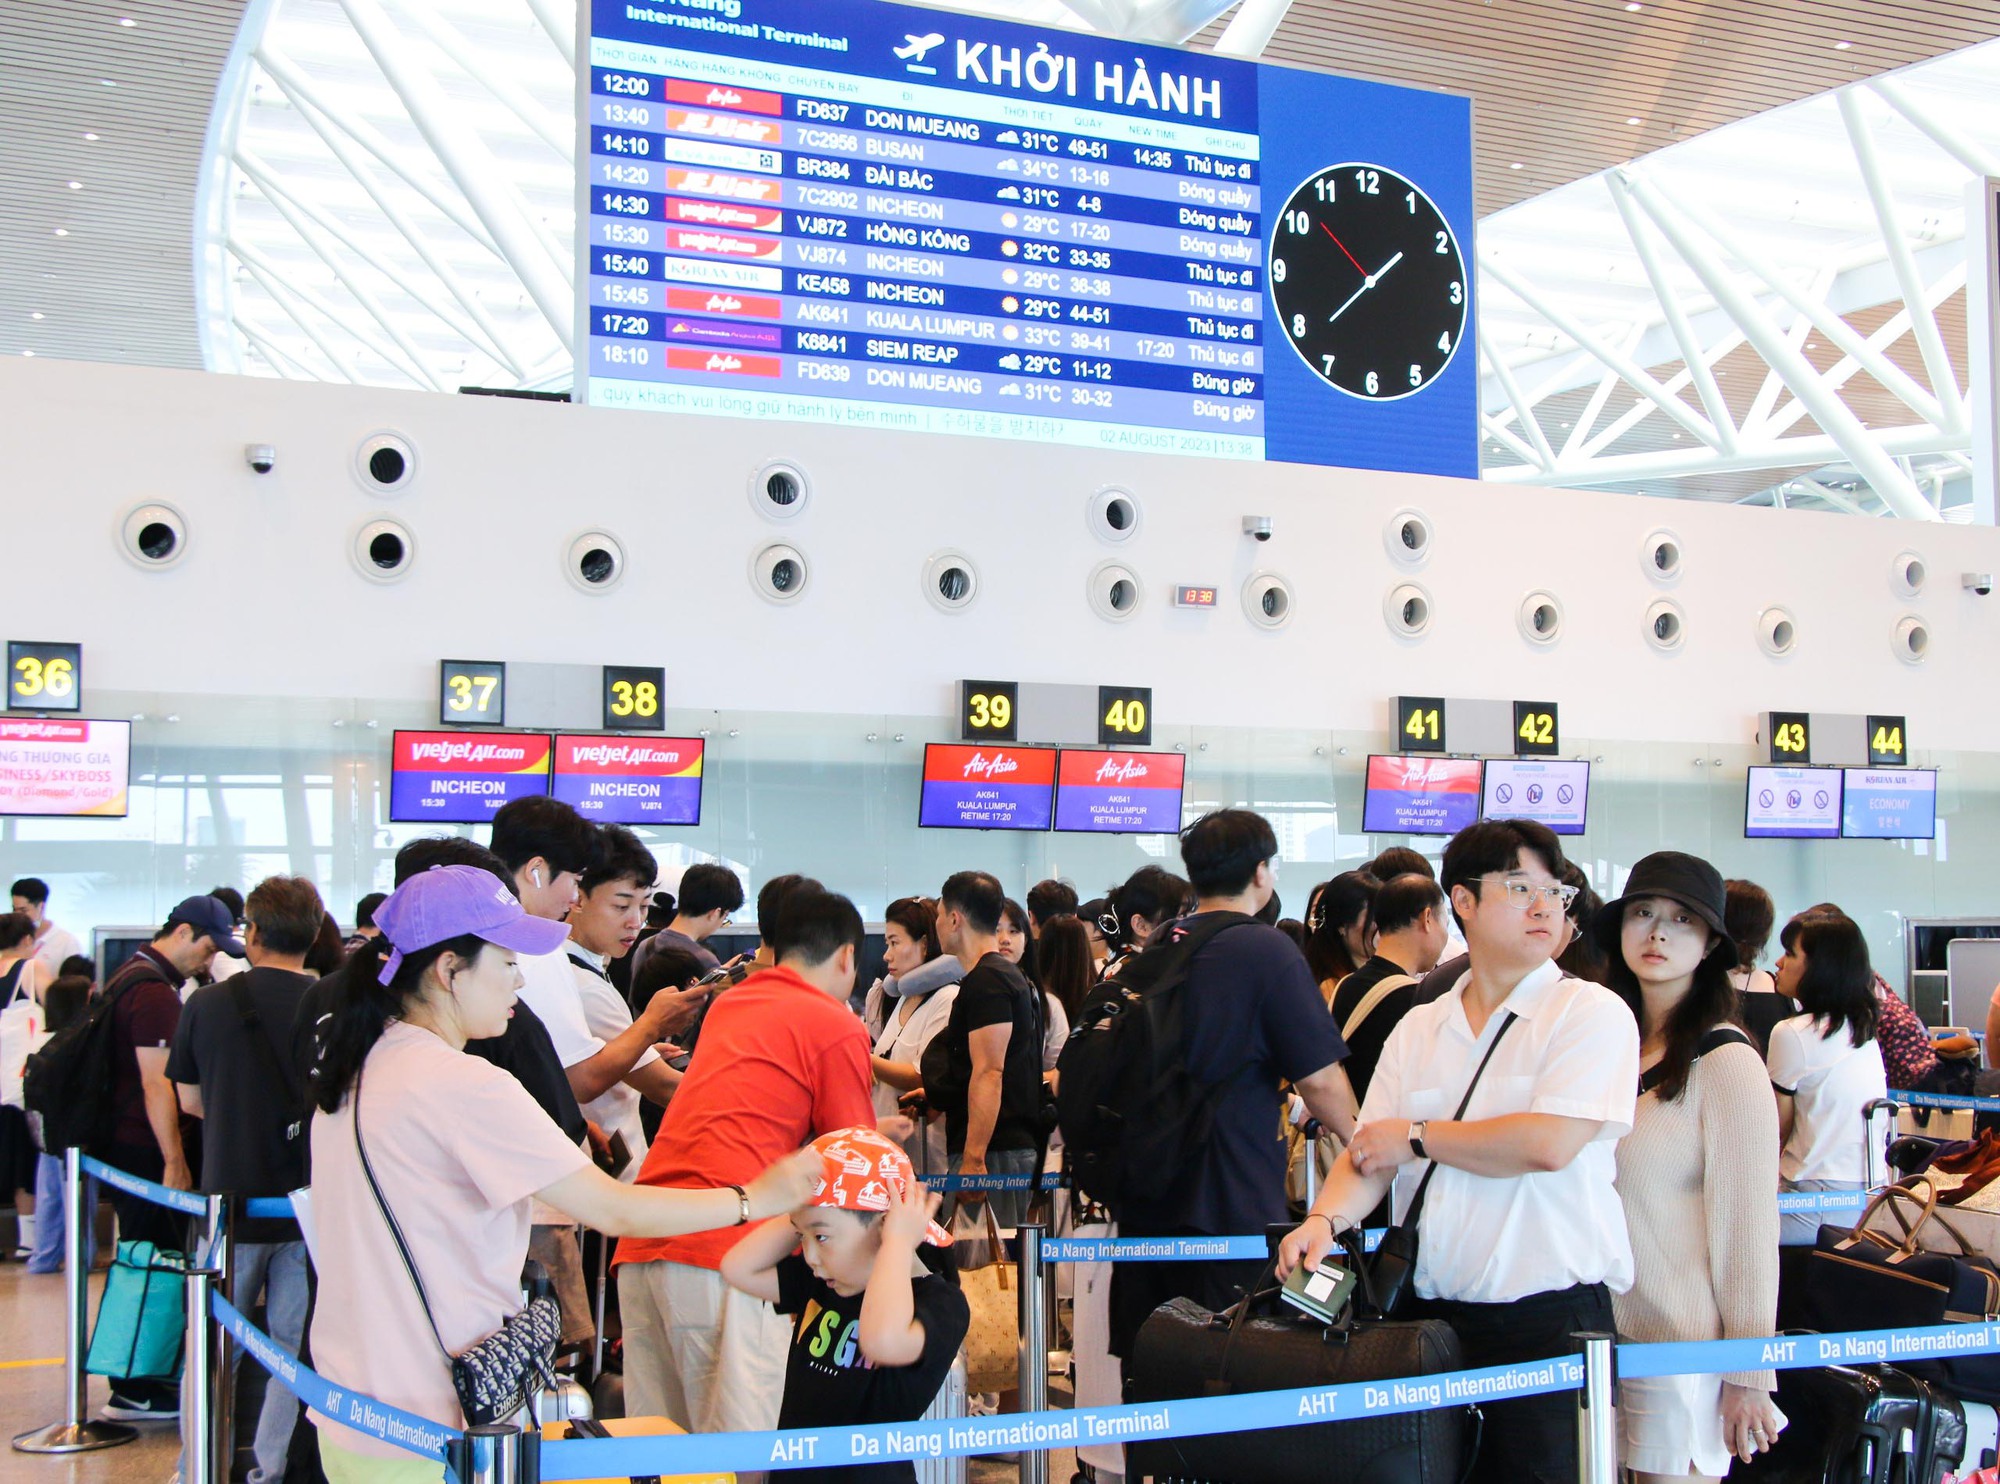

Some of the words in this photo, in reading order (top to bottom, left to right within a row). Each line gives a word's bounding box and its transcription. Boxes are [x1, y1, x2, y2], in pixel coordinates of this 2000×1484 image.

[627, 1, 758, 36] International
[761, 25, 848, 51] Terminal
[957, 39, 1076, 96] KHỞI
[1095, 57, 1221, 118] HÀNH
[603, 74, 649, 95] 12:00
[797, 99, 849, 121] FD637
[866, 109, 903, 130] DON
[907, 115, 980, 140] MUEANG
[1023, 131, 1059, 152] 31°C
[1069, 139, 1107, 159] 49-51
[1135, 148, 1172, 168] 14:35
[1185, 155, 1212, 173] Thủ
[1214, 158, 1235, 180] tục
[1238, 163, 1251, 179] đi
[1129, 124, 1150, 136] NEW
[1154, 128, 1178, 141] TIME
[603, 103, 649, 126] 13:40
[865, 137, 924, 161] BUSAN
[1022, 159, 1059, 180] 34°C
[1070, 166, 1110, 186] 13-16
[1179, 180, 1216, 204] Đóng
[603, 134, 649, 155] 14:10
[797, 157, 850, 179] BR384
[865, 165, 894, 185] ĐÀI
[1023, 187, 1059, 207] 31°C
[1077, 195, 1102, 212] 4-8
[1179, 208, 1216, 231] Đóng
[1314, 177, 1336, 203] 11
[1355, 169, 1380, 195] 12
[603, 163, 649, 185] 14:20
[866, 195, 944, 221] INCHEON
[1023, 214, 1060, 235] 29°C
[1070, 221, 1111, 241] 17-20
[1405, 191, 1416, 214] 1
[1285, 209, 1310, 235] 10
[603, 193, 649, 215] 14:30
[797, 215, 847, 237] VJ872
[921, 228, 970, 251] KÔNG
[1024, 243, 1060, 263] 32°C
[1070, 249, 1111, 269] 33-35
[1187, 263, 1214, 281] Thủ
[1217, 267, 1238, 285] tục
[1240, 270, 1253, 286] đi
[1435, 230, 1449, 254] 2
[603, 223, 649, 245] 15:30
[797, 244, 847, 266] VJ874
[866, 252, 944, 277] INCHEON
[1023, 270, 1060, 291] 29°C
[1272, 258, 1287, 283] 9
[603, 254, 649, 274] 15:40
[797, 273, 850, 295] KE458
[867, 281, 944, 305] INCHEON
[1024, 298, 1060, 318] 29°C
[1070, 305, 1109, 323] 44-51
[1188, 317, 1214, 335] Thủ
[1217, 321, 1238, 342] tục
[1241, 324, 1254, 339] đi
[1449, 281, 1463, 305] 3
[602, 284, 649, 305] 15:45
[797, 303, 848, 324] AK641
[866, 310, 923, 332] KUALA
[925, 316, 996, 339] LUMPUR
[1024, 326, 1061, 347] 33°C
[1136, 339, 1175, 359] 17:20
[1293, 313, 1306, 338] 8
[603, 314, 649, 335] 17:20
[797, 332, 846, 352] K6841
[867, 339, 909, 359] SIEM
[912, 343, 959, 363] REAP
[1025, 355, 1061, 374] 29°C
[1073, 360, 1112, 379] 11-12
[1193, 372, 1230, 394] Đúng
[1437, 330, 1452, 355] 4
[1322, 354, 1336, 377] 7
[1409, 364, 1423, 387] 5
[602, 344, 649, 365] 18:10
[867, 368, 905, 388] DON
[909, 372, 982, 395] MUEANG
[1025, 383, 1062, 403] 31°C
[1071, 388, 1113, 408] 30-32
[1193, 399, 1230, 422] Đúng
[1365, 371, 1379, 395] 6
[1100, 428, 1116, 444] 02
[1119, 431, 1176, 449] AUGUST
[1180, 436, 1211, 453] 2023
[14, 657, 73, 696] 36
[449, 675, 497, 712] 37
[611, 680, 658, 717] 38
[969, 693, 1011, 728] 39
[1105, 699, 1145, 733] 40
[1406, 709, 1439, 740] 41
[1519, 713, 1554, 744] 42
[1774, 723, 1806, 752] 43
[1872, 726, 1903, 755] 44
[87, 753, 110, 764] GIA
[431, 780, 505, 794] INCHEON
[590, 783, 660, 796] INCHEON
[957, 801, 982, 810] KUALA
[984, 803, 1016, 811] LUMPUR
[961, 812, 990, 820] RETIME
[992, 813, 1011, 821] 17:20
[1090, 806, 1114, 814] KUALA
[1116, 807, 1147, 815] LUMPUR
[1419, 809, 1448, 817] LUMPUR
[1869, 799, 1910, 810] ECONOMY
[1094, 816, 1122, 824] RETIME
[1399, 818, 1425, 826] RETIME
[961, 1178, 974, 1188] Da
[978, 1178, 1004, 1189] Nang
[1818, 1193, 1860, 1207] Terminal
[1042, 1243, 1059, 1258] Da
[1063, 1243, 1095, 1261] Nang
[1098, 1242, 1175, 1257] International
[1178, 1240, 1229, 1255] Terminal
[1761, 1341, 1797, 1363] AHT
[1819, 1339, 1842, 1359] Da
[1845, 1337, 1887, 1360] Nang
[1891, 1327, 1989, 1354] International
[1297, 1391, 1338, 1417] AHT
[1364, 1387, 1390, 1409] Da
[1393, 1383, 1442, 1406] Nang
[1445, 1364, 1555, 1399] International
[326, 1391, 343, 1414] AHT
[351, 1400, 362, 1423] Da
[363, 1405, 386, 1438] Nang
[388, 1414, 443, 1453] International
[770, 1436, 819, 1462] AHT
[851, 1433, 880, 1457] Da
[886, 1430, 942, 1457] Nang
[948, 1416, 1079, 1450] International
[1083, 1408, 1170, 1438] Terminal
